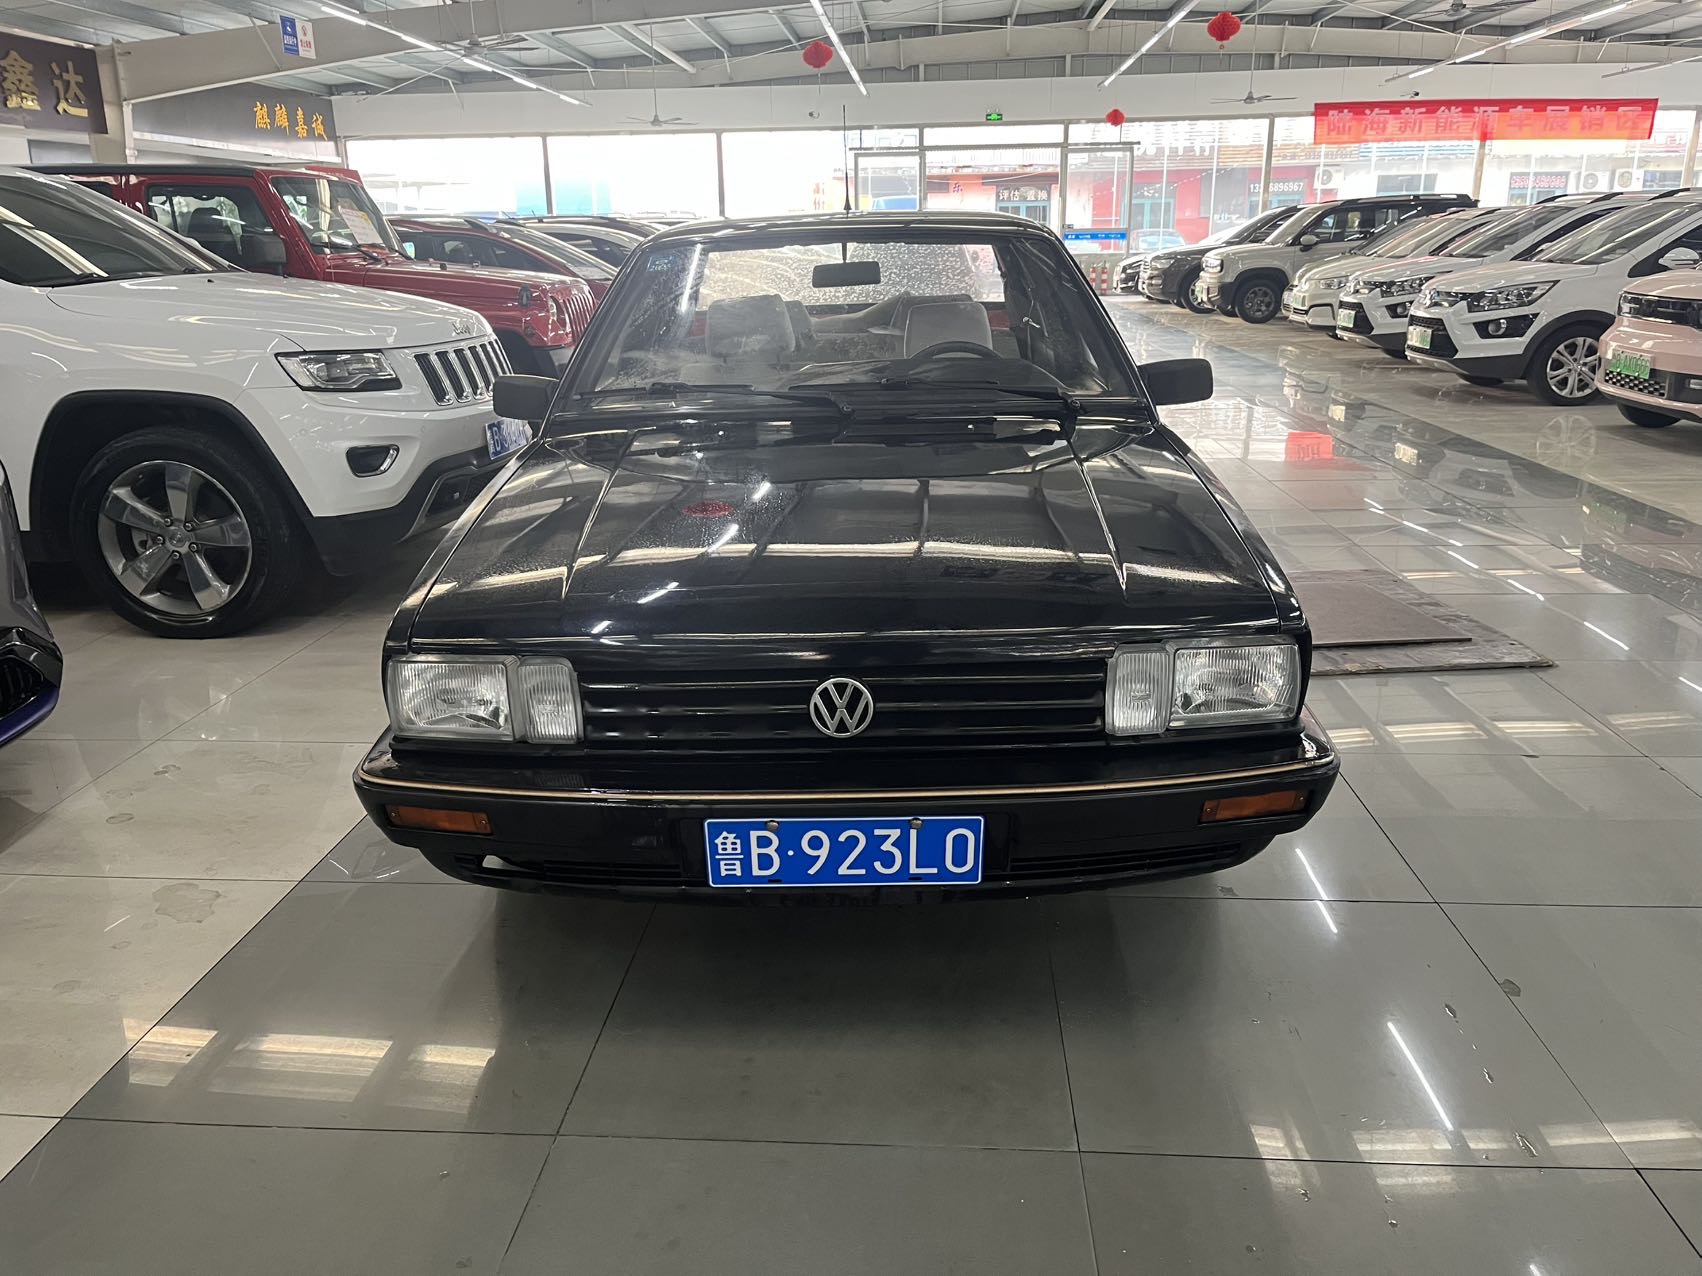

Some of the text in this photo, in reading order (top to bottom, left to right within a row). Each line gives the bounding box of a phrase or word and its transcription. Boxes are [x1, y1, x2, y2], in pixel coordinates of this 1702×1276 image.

[0, 50, 88, 117] 鑫达
[253, 102, 328, 141] 麒麟嘉诚
[1327, 106, 1643, 135] 陆海新能源车展销区
[999, 189, 1020, 201] 评估
[1249, 182, 1304, 193] 136896967
[809, 677, 874, 739] VW
[714, 827, 976, 877] 鲁B·923L0
